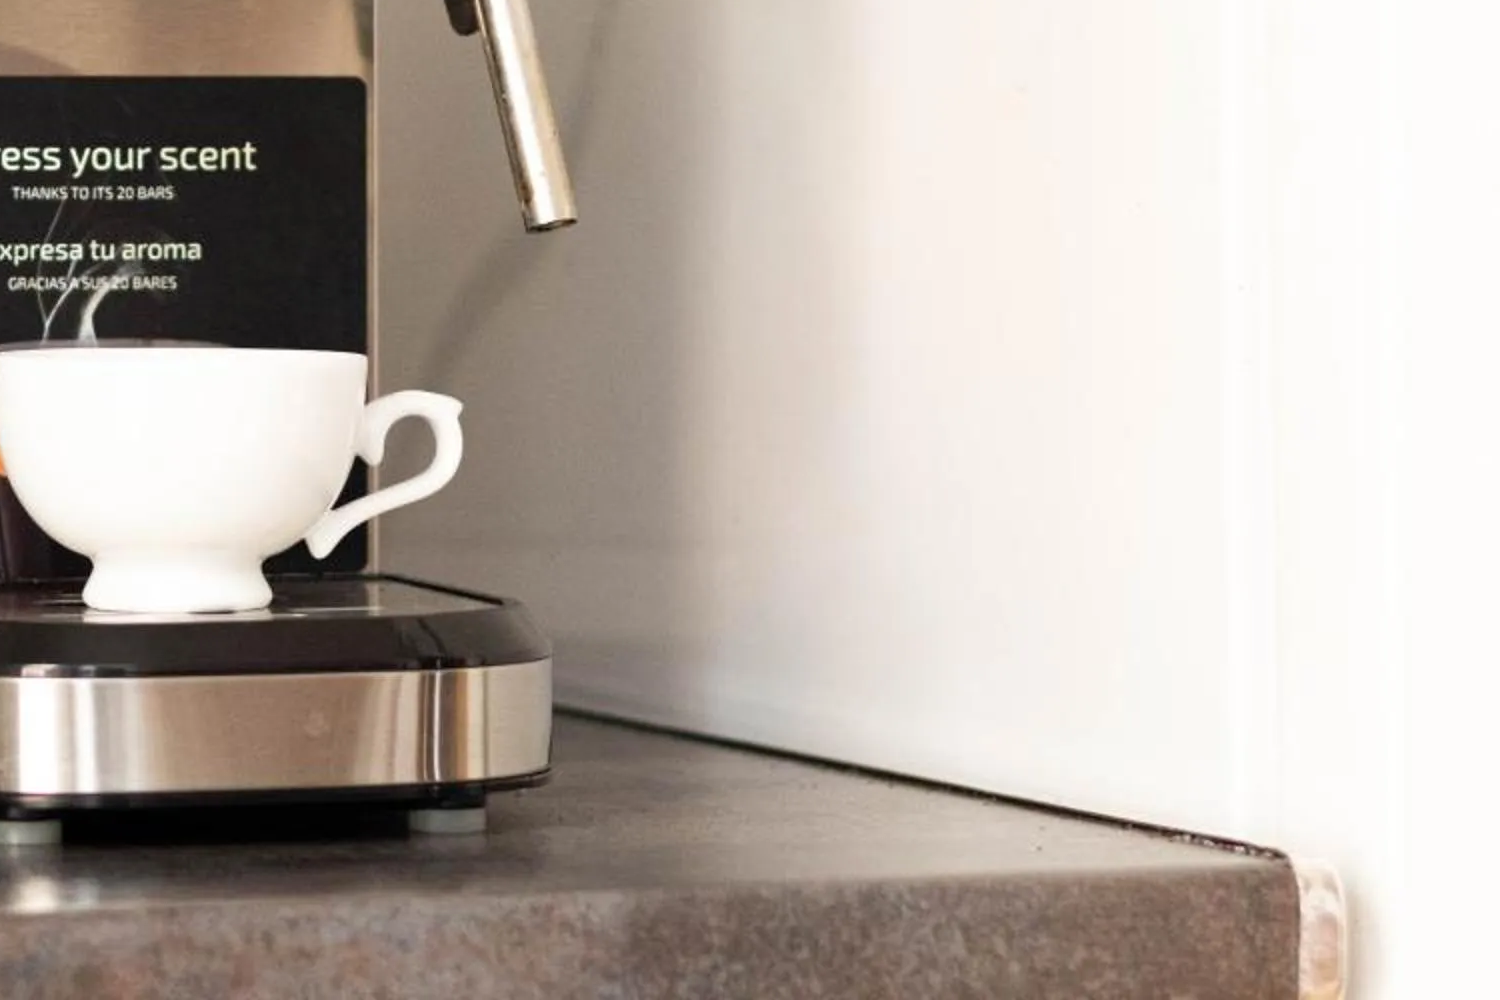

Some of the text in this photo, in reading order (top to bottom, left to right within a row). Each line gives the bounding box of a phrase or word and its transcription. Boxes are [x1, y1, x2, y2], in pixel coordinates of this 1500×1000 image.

[70, 146, 151, 178] your
[159, 141, 257, 172] scent
[12, 186, 174, 200] THANKS TO ITS 20 BARS
[90, 241, 115, 260] tu
[122, 243, 202, 261] aroma
[7, 276, 68, 291] GRACIAS
[83, 276, 107, 291] SUS
[132, 275, 178, 290] BARES
